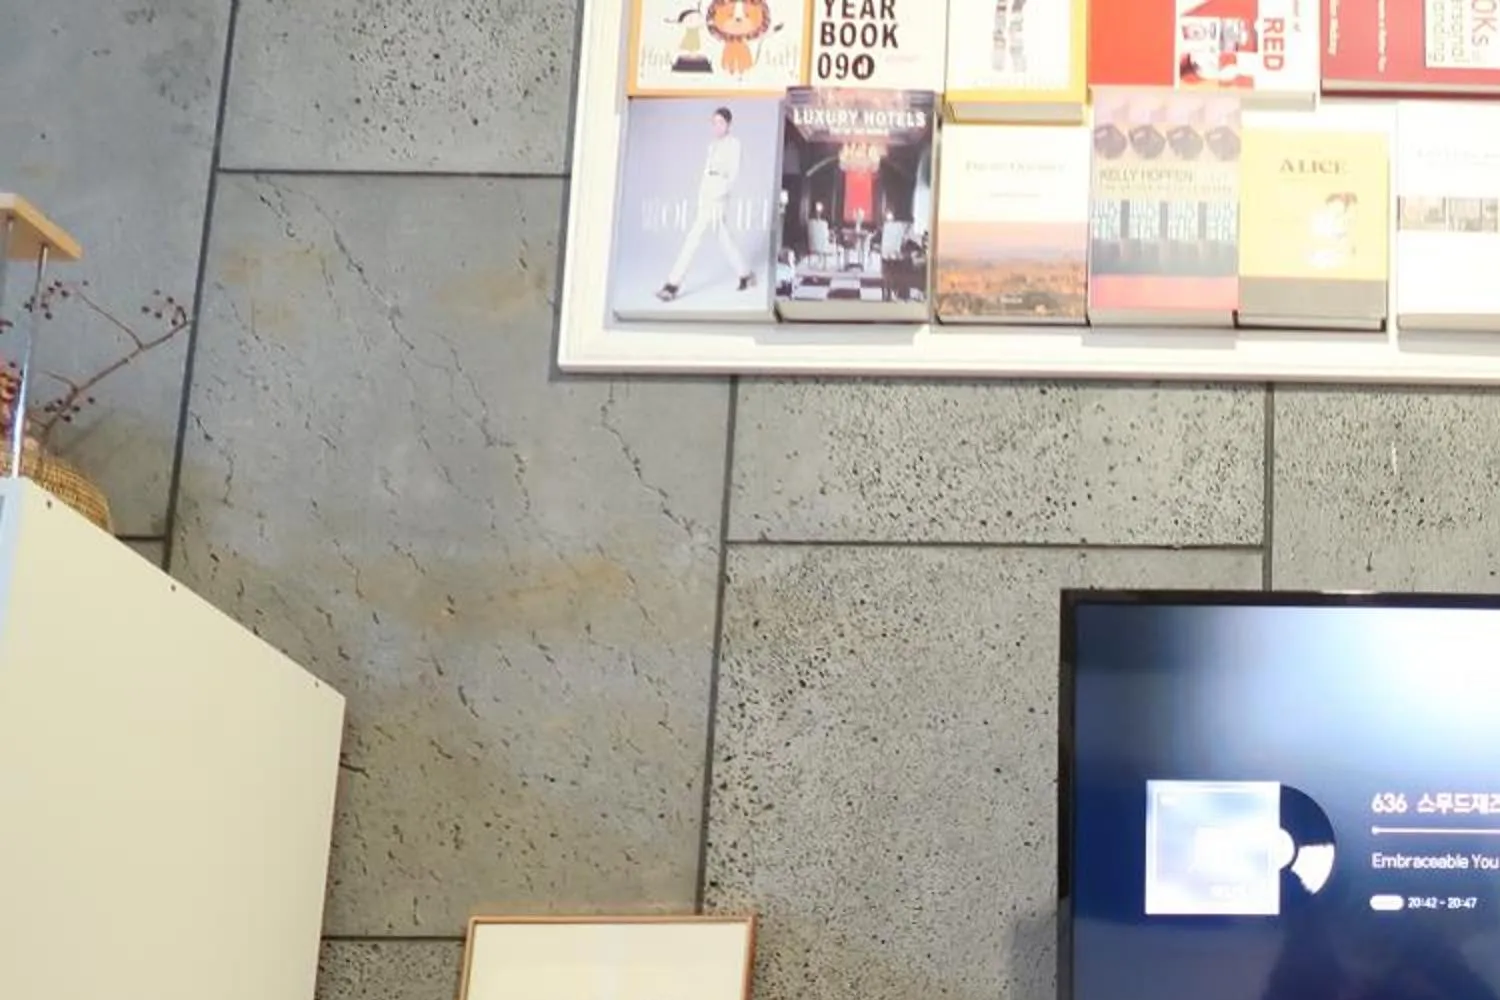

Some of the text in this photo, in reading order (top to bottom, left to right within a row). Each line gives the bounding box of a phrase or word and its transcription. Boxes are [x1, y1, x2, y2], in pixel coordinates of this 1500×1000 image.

[822, 0, 897, 21] YEAR
[820, 22, 899, 48] BOOK
[1263, 16, 1286, 72] RED
[793, 107, 926, 129] LUXURY HOTELS
[1279, 158, 1347, 174] ALICE
[1370, 792, 1408, 814] 636
[1370, 852, 1469, 870] Embraceable
[1471, 852, 1500, 871] You
[1407, 896, 1438, 910] 20:42
[1447, 896, 1479, 910] 20:47
